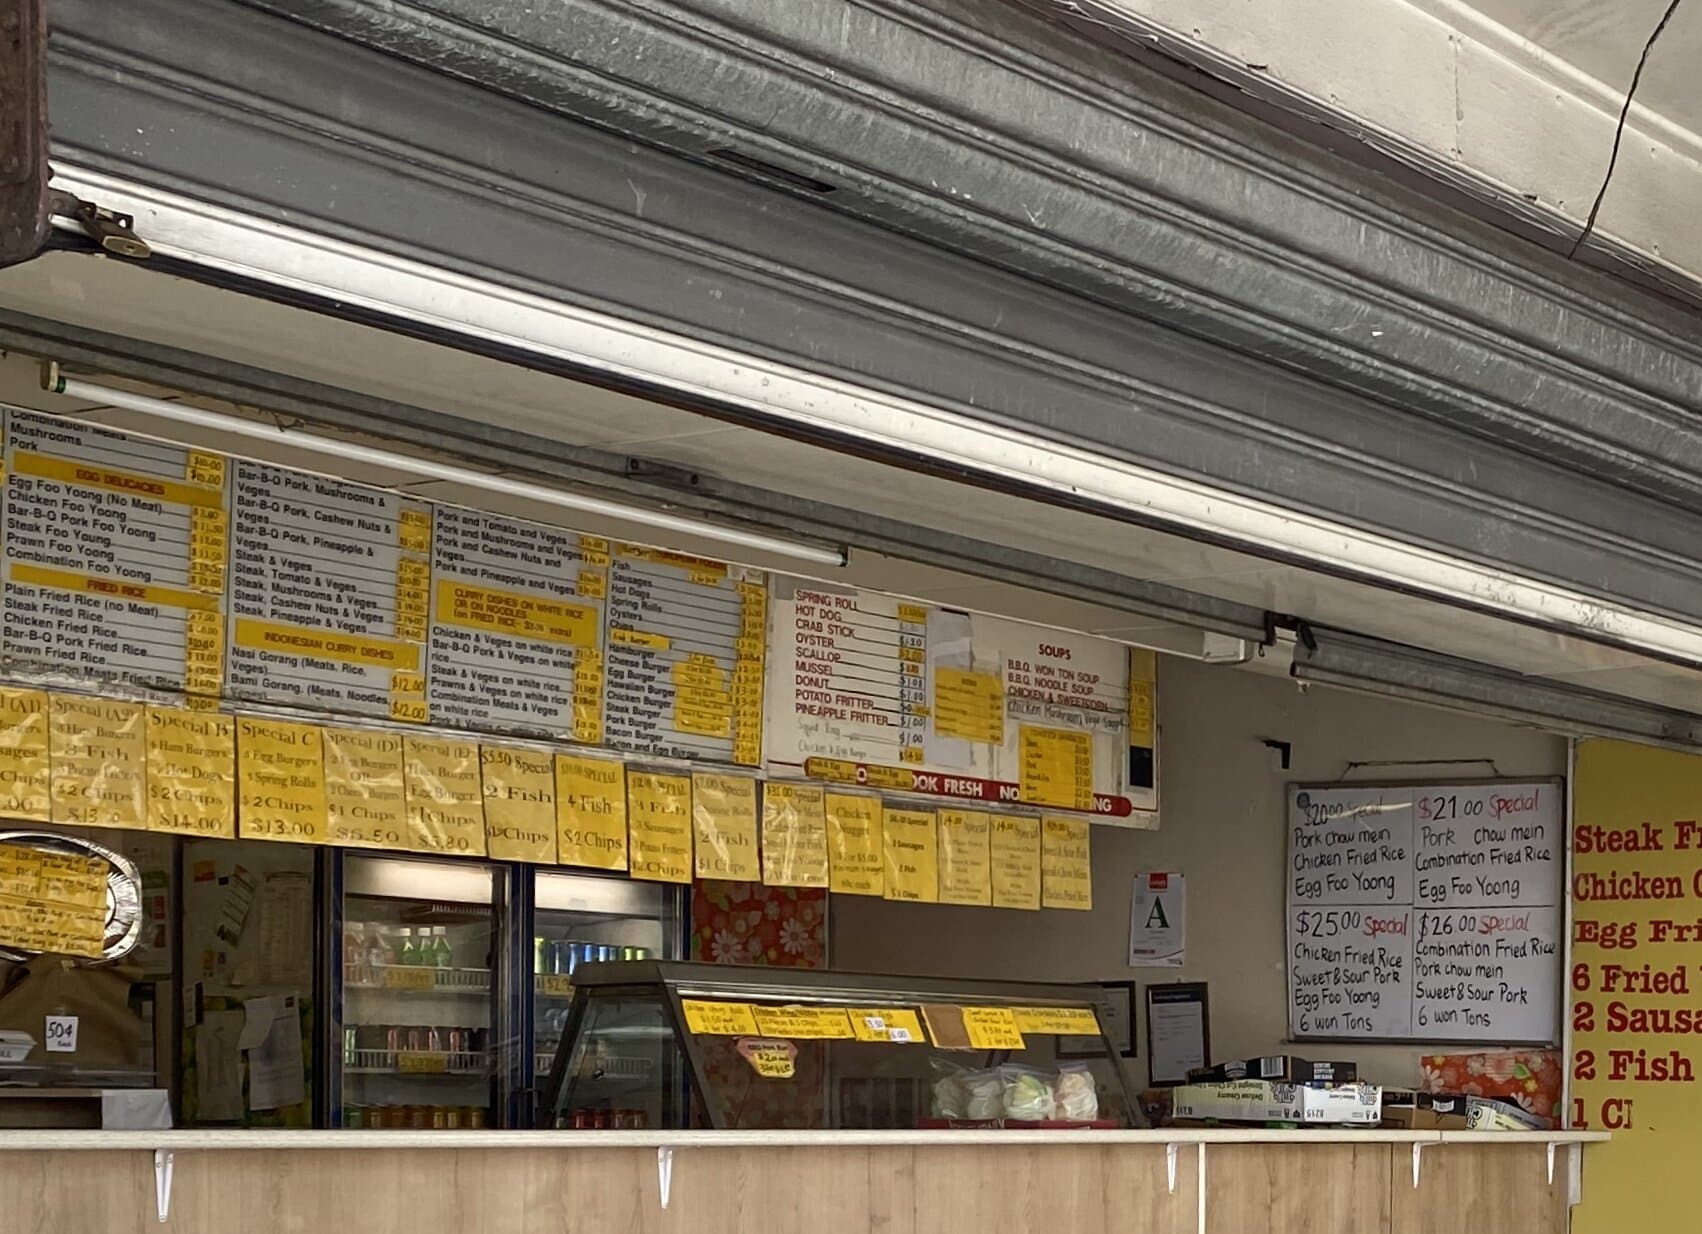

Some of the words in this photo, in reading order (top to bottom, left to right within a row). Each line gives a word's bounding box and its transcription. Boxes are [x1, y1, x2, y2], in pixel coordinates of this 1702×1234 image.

[10, 437, 38, 451] Pork
[8, 475, 32, 490] Egg
[36, 480, 60, 493] Foo
[65, 485, 102, 503] Yoong
[8, 489, 58, 507] Chicken
[62, 499, 85, 512] Foo
[89, 504, 127, 522] Yoong
[612, 559, 630, 571] Fish
[612, 572, 652, 587] Sausages
[796, 591, 831, 607] SPRING
[835, 597, 857, 611] ROLL
[796, 605, 815, 616] HOT
[820, 608, 842, 622] DOG
[796, 619, 823, 632] CRAB
[828, 624, 855, 639] STICK
[796, 634, 834, 647] OYSTER
[796, 648, 840, 663] SCALLOP
[1039, 643, 1071, 660] SOUPS
[796, 661, 833, 676] MUSSEL
[1034, 663, 1055, 678] WON
[1059, 667, 1075, 681] TON
[1078, 670, 1100, 684] SOUP
[796, 675, 829, 689] DONUT
[796, 689, 831, 703] POTATO
[836, 695, 874, 709] FRITTER
[151, 711, 209, 736] Special
[796, 702, 846, 720] PINEAPPLE
[851, 710, 889, 725] FRITTER
[242, 722, 296, 746] Special
[302, 732, 315, 746] C
[508, 787, 552, 803] Fish
[944, 782, 983, 797] FRESH
[581, 794, 612, 814] Fish
[1490, 789, 1539, 820] Special
[584, 831, 623, 850] Chips
[1294, 827, 1321, 848] Pork
[1421, 826, 1455, 847] Pork
[1511, 825, 1544, 840] mein
[1575, 822, 1663, 853] Steak
[1294, 852, 1341, 871] Chicken
[1347, 849, 1377, 864] Fried
[1380, 845, 1405, 860] Rice
[1416, 850, 1485, 871] Combination
[1490, 848, 1521, 866] Fried
[1525, 846, 1551, 862] Rice
[1296, 877, 1321, 899] Egg
[1327, 873, 1349, 891] Foo
[1352, 871, 1395, 899] Yoong
[1419, 879, 1446, 903] Egg
[1452, 877, 1472, 894] Foo
[1476, 875, 1520, 899] Yoong
[1574, 872, 1684, 902] Chicken
[1145, 896, 1170, 928] A
[1575, 920, 1638, 949] Egg
[1345, 946, 1375, 965] Fried
[1378, 947, 1402, 968] Rice
[1416, 940, 1490, 957] Combination
[1496, 939, 1527, 958] Fried
[1530, 937, 1556, 956] Rice
[1374, 967, 1400, 984] Pork
[1415, 957, 1441, 977] Pork
[1475, 965, 1503, 978] mein
[1572, 963, 1591, 992] 6
[1600, 964, 1689, 994] Fried
[1295, 988, 1319, 1012] Egg
[1322, 988, 1341, 1004] Foo
[1345, 988, 1380, 1009] Yoong
[1499, 982, 1527, 1004] Pork
[1300, 1014, 1310, 1032] 6
[1342, 1012, 1373, 1032] Tons
[1419, 1005, 1428, 1026] 6
[1461, 1008, 1491, 1027] Tons
[1573, 1002, 1595, 1032] 2
[1574, 1050, 1596, 1081] 2
[1608, 1049, 1695, 1082] Fish
